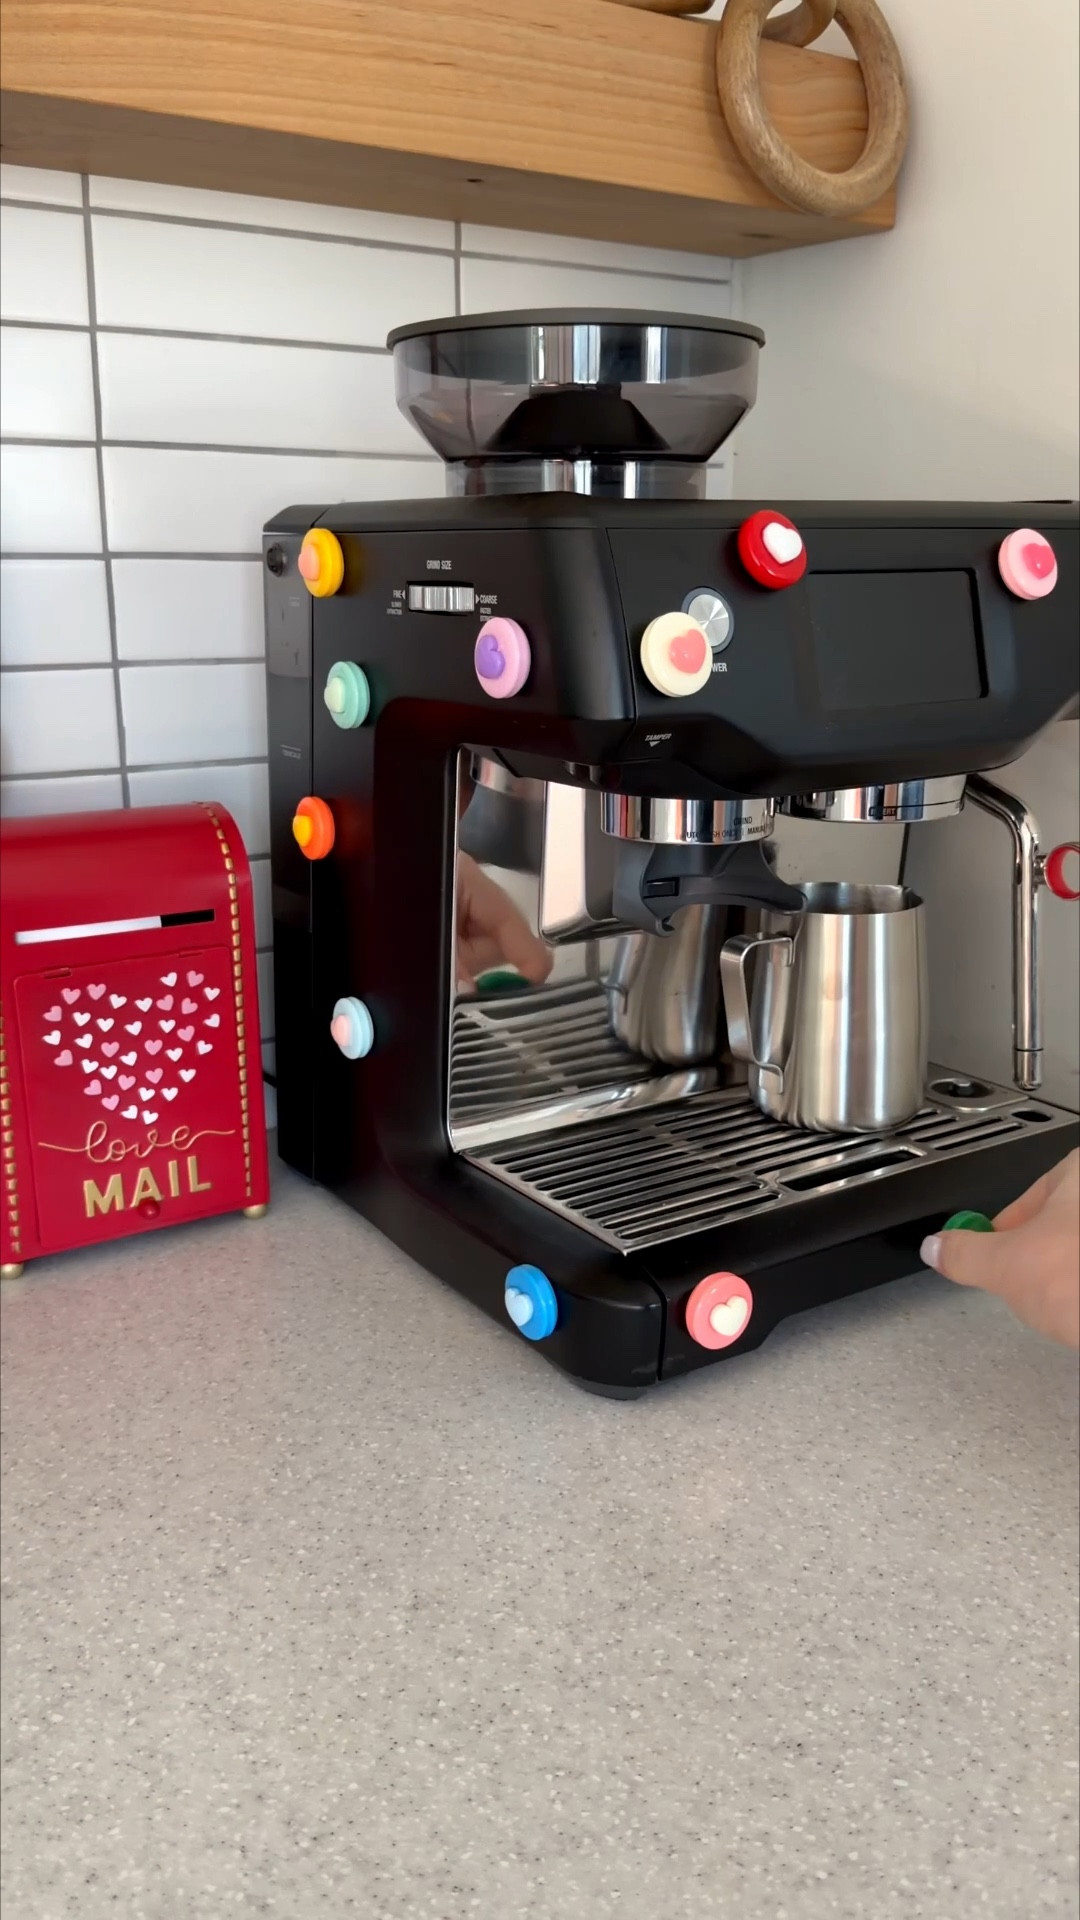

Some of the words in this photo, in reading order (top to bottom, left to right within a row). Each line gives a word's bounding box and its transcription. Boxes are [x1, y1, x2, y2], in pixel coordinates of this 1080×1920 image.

[427, 559, 440, 570] GRIND
[441, 560, 452, 570] SIZE
[480, 594, 498, 605] COARSE
[712, 662, 728, 673] WER
[645, 733, 672, 742] TAMPER
[38, 1120, 236, 1163] love
[83, 1155, 212, 1218] MAIL
